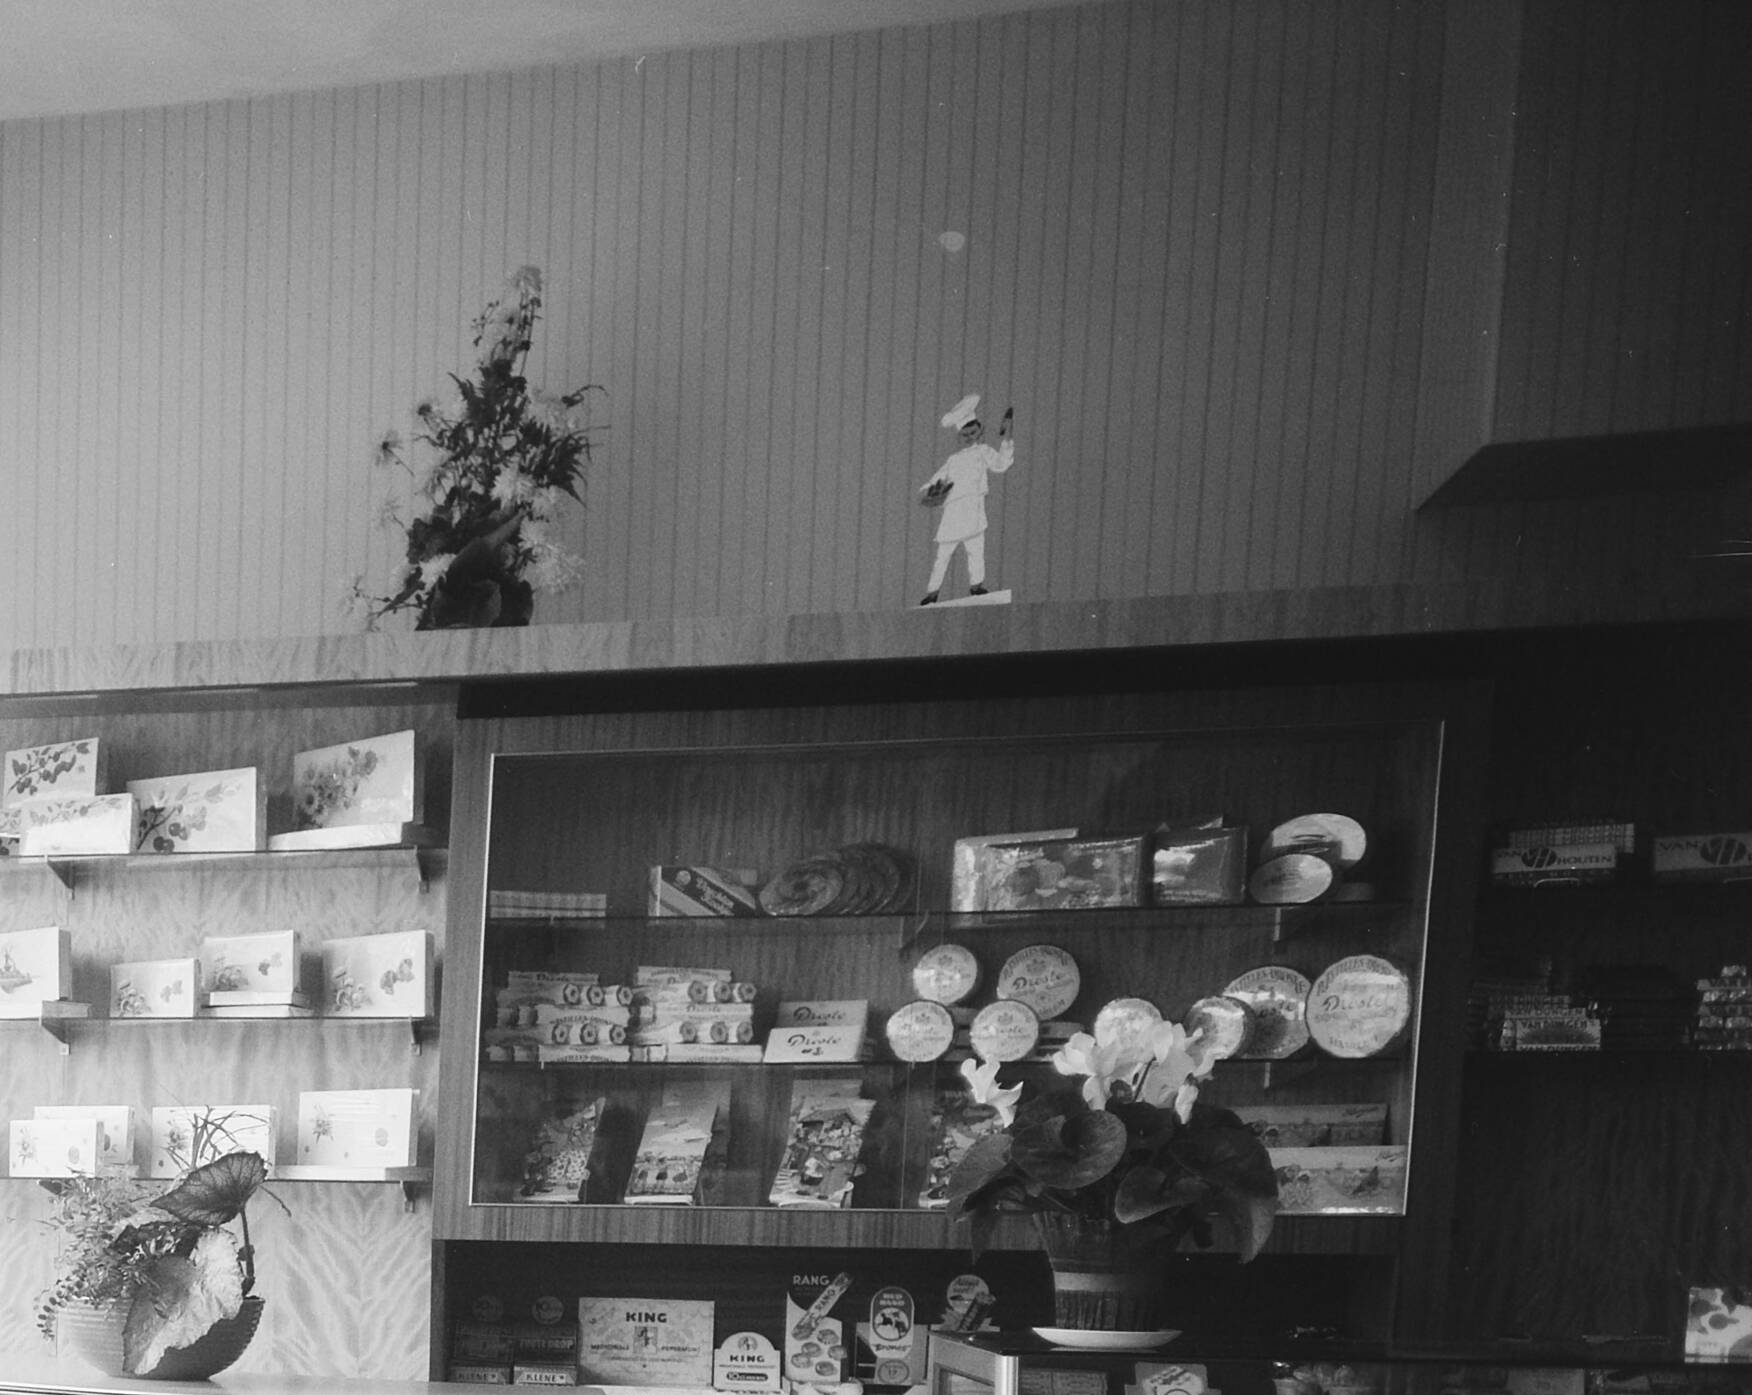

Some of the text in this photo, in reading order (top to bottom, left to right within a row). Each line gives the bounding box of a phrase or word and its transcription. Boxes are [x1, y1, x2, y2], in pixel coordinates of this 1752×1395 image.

[1659, 840, 1699, 852] VAN
[1556, 854, 1613, 866] HOUTEN
[792, 1274, 830, 1286] RANG
[625, 1312, 668, 1324] KING
[730, 1354, 766, 1363] KING
[526, 1373, 556, 1382] KLENE
